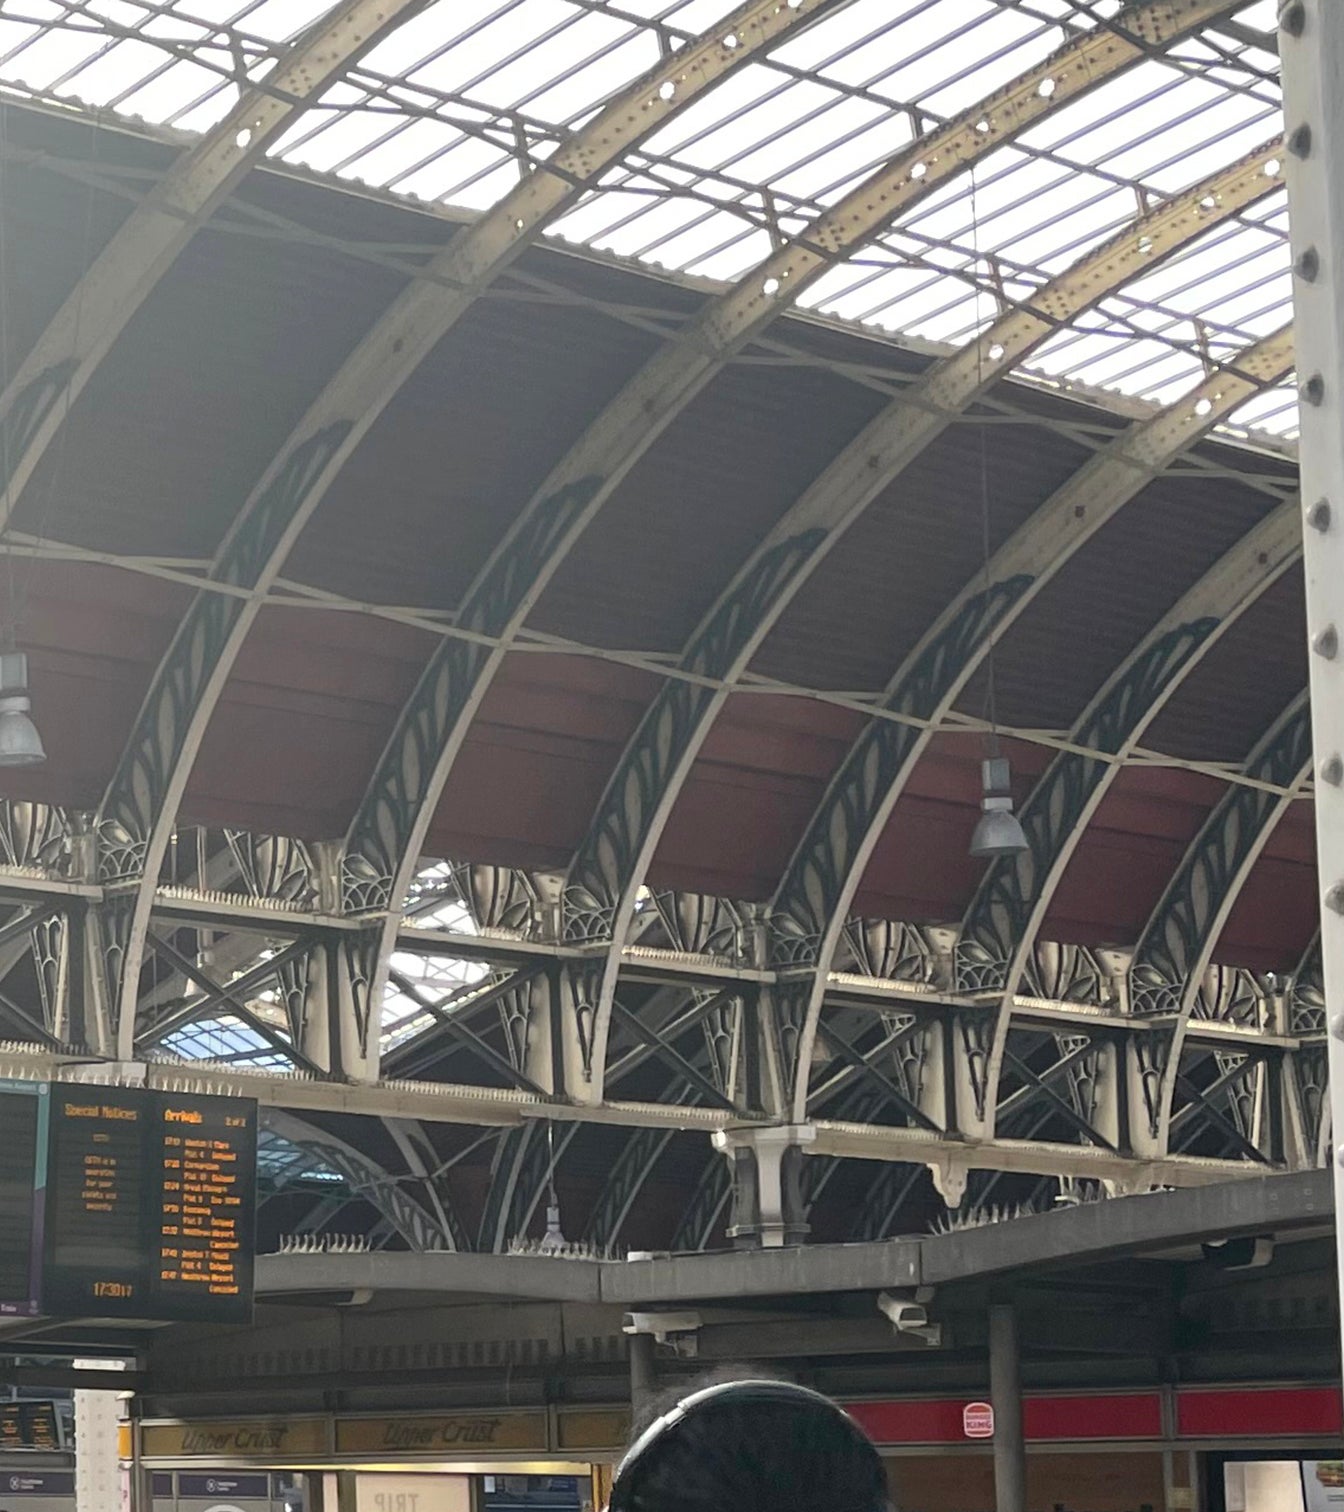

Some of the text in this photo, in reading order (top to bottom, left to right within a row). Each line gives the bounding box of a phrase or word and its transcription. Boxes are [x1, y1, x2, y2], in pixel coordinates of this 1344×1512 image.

[64, 1103, 137, 1121] Special Notices
[383, 1420, 499, 1446] Upper Crust
[966, 1420, 992, 1429] KING
[182, 1427, 289, 1451] Upper Crust
